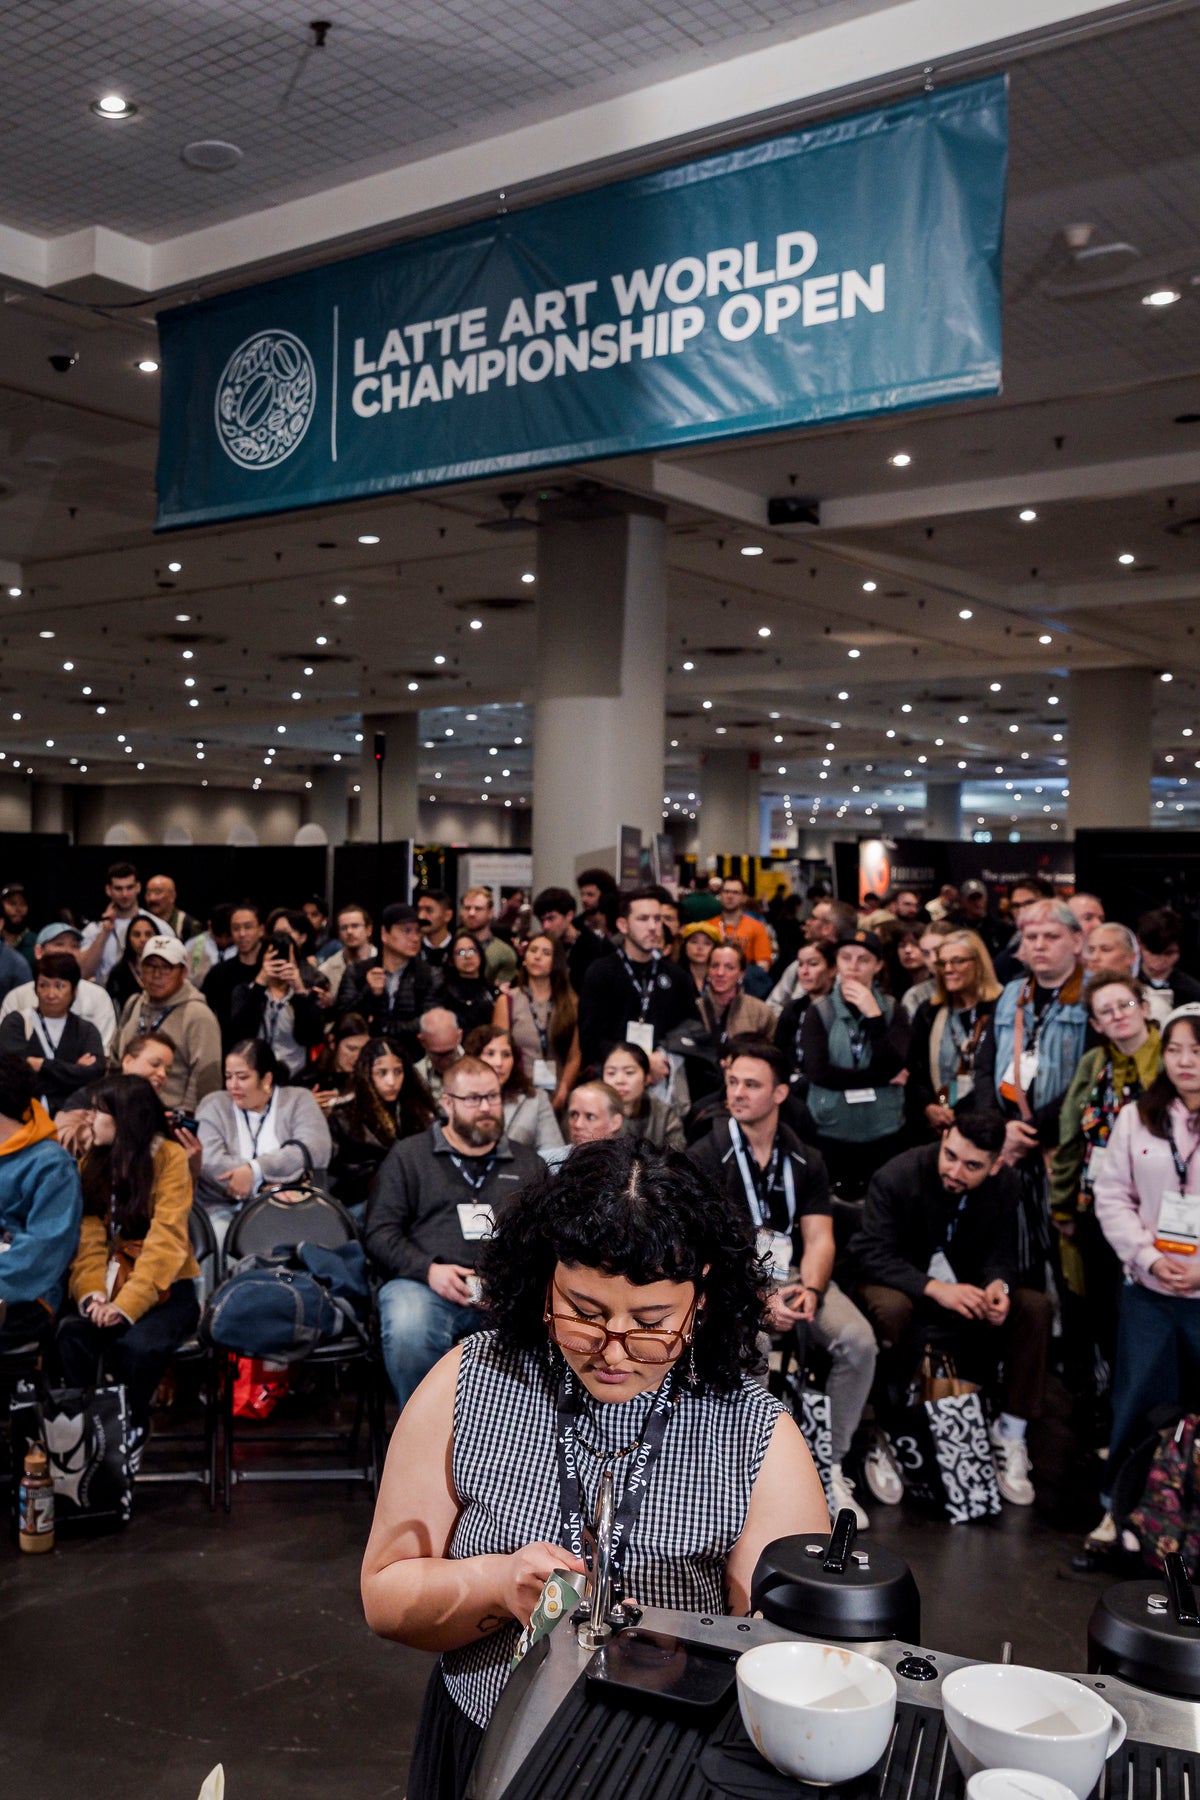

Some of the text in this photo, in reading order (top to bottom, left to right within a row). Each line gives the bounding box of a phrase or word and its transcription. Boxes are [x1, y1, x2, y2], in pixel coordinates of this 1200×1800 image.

[353, 230, 819, 377] LATTE ART WORLD
[351, 263, 887, 418] CHAMPIONSHIP OPEN
[654, 1372, 673, 1415] ONIN
[559, 1426, 577, 1479] MONIN
[627, 1441, 652, 1494] MONIN
